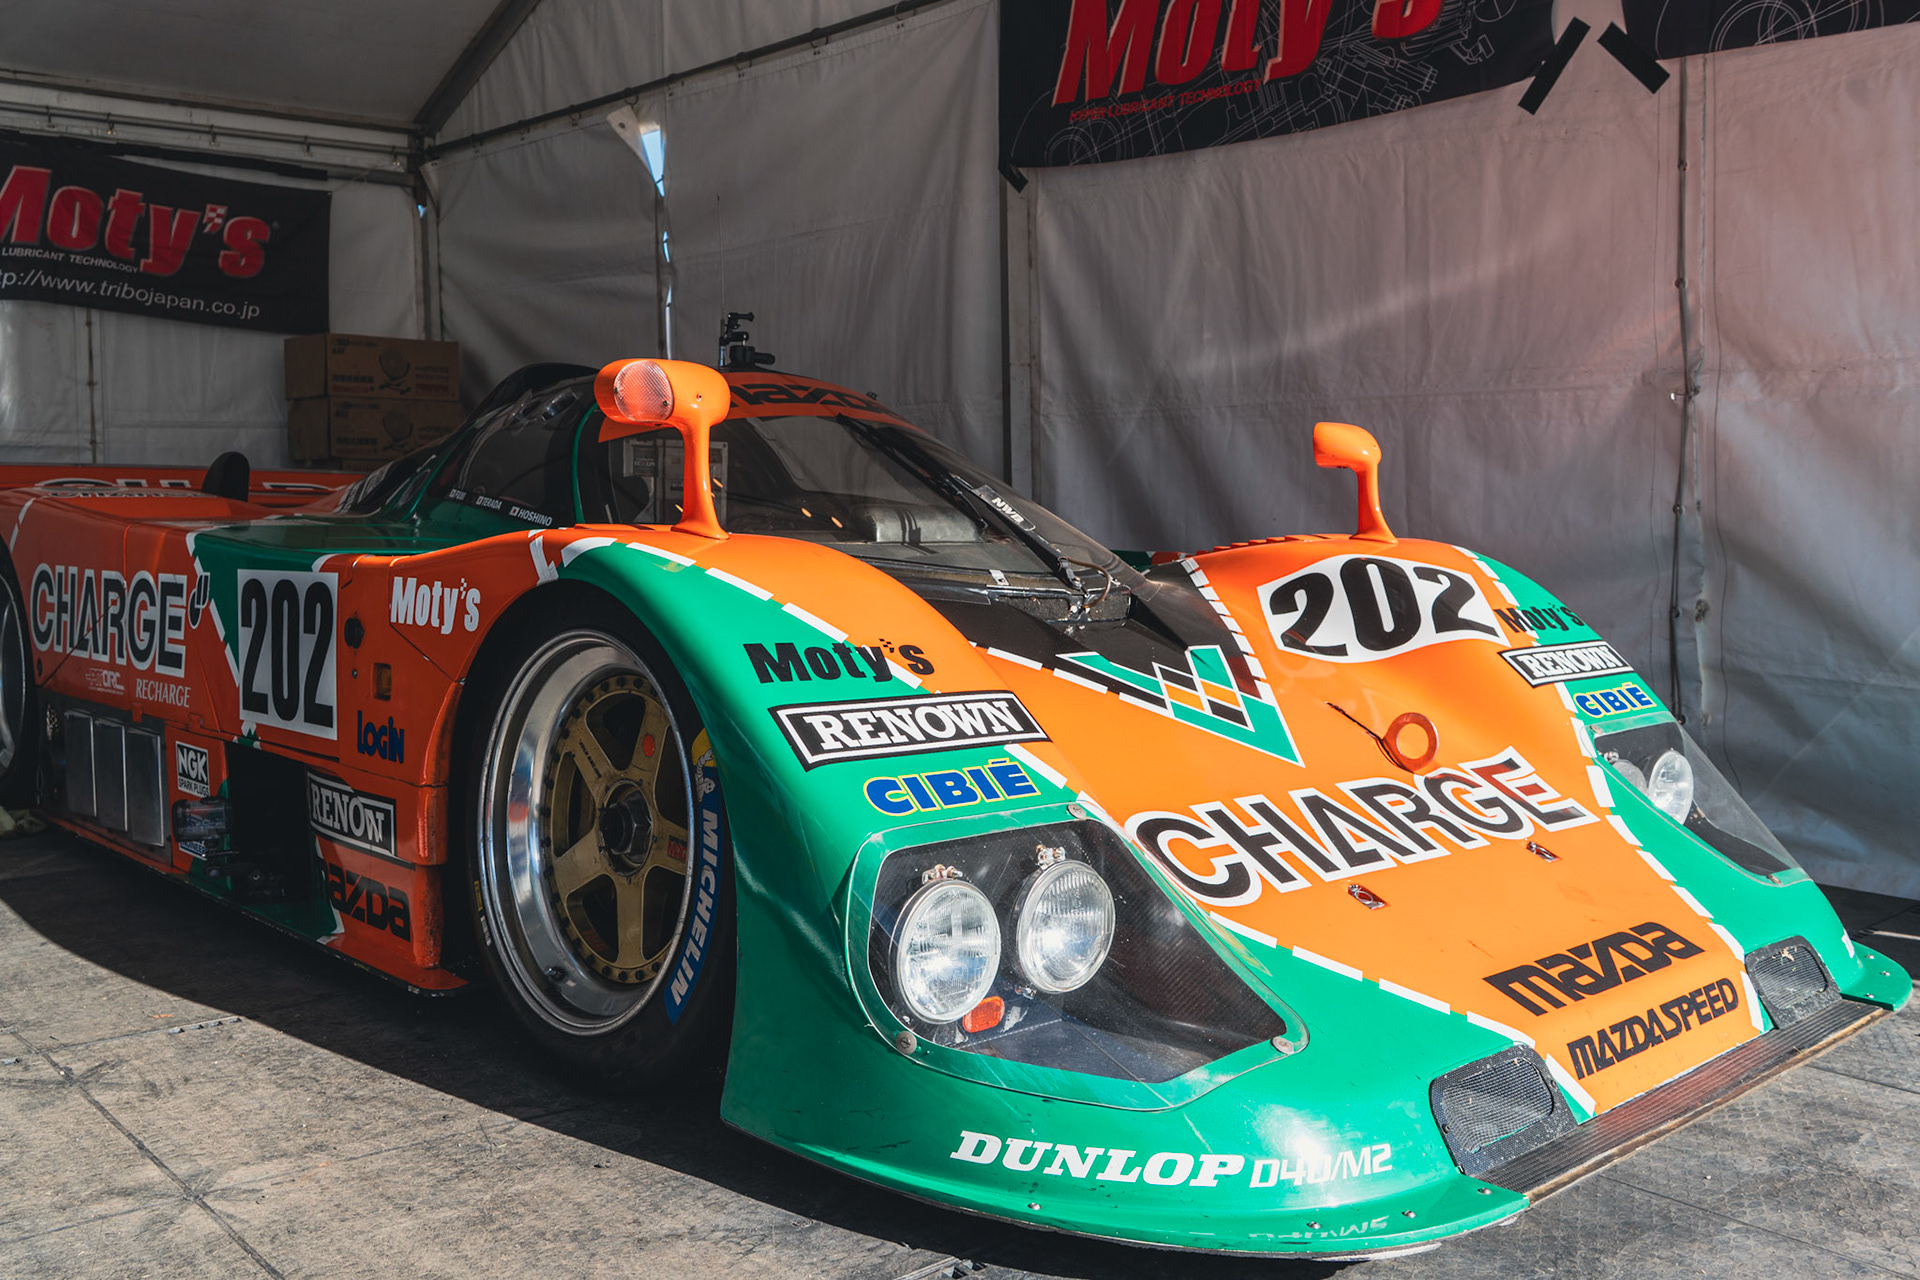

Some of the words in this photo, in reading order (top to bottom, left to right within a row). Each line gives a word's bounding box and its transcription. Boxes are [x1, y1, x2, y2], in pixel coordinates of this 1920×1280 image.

[1107, 95, 1176, 118] LUBRICANT
[1179, 79, 1263, 107] TECHNOLOGY
[2, 247, 66, 262] LUBRICANT
[69, 254, 139, 274] TECHNOLOGY
[518, 508, 553, 527] HOSHINO
[31, 562, 188, 678] CHARGE
[390, 576, 481, 635] Moty's
[1269, 557, 1500, 657] 202
[1494, 602, 1584, 632] Moty's
[240, 577, 334, 729] 202
[742, 638, 935, 684] Moty's
[1516, 646, 1624, 678] RENOWN
[135, 678, 191, 708] RECHARGE
[804, 700, 1023, 750] RENOWN
[177, 747, 208, 783] NGK
[178, 777, 194, 792] SPARK
[193, 783, 209, 797] PLUGS
[1124, 745, 1600, 907] CHARGE
[670, 808, 719, 1005] MICHELIN
[1566, 978, 1738, 1081] MAZDASPEED
[950, 1130, 1244, 1188] DUNLOP
[1250, 1143, 1393, 1188] D40/M2
